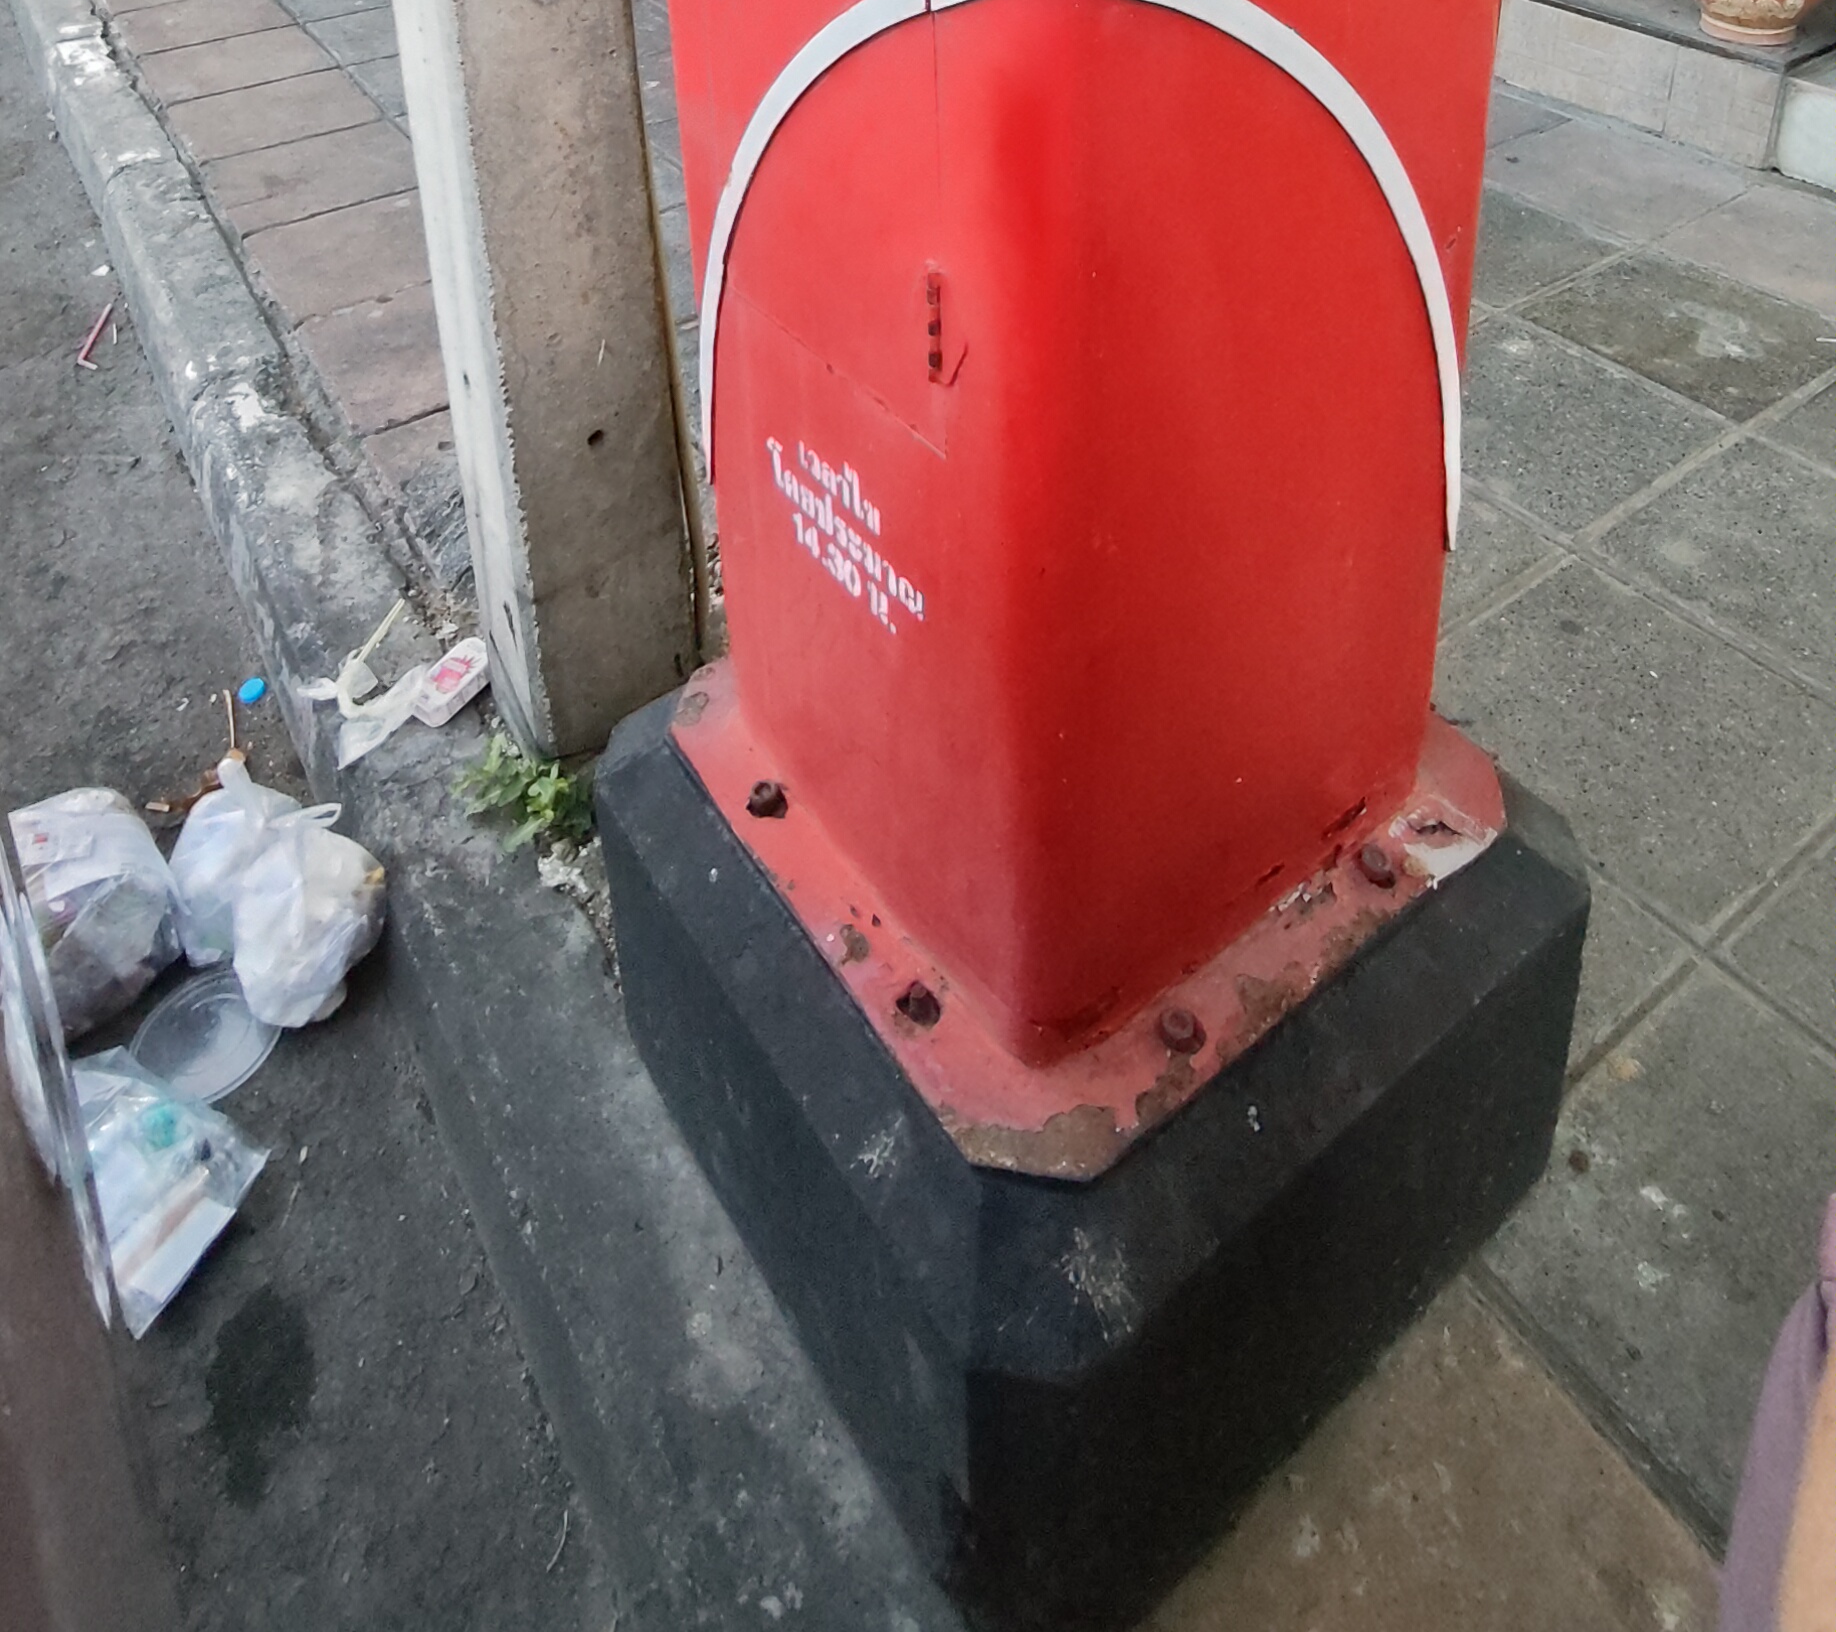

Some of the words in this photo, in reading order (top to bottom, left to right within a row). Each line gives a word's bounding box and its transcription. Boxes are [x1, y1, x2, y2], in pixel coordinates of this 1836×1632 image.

[766, 436, 925, 621] โดยประมาณ
[797, 439, 881, 536] เวลาไข
[792, 511, 861, 597] 14.30
[868, 581, 897, 634] น.
